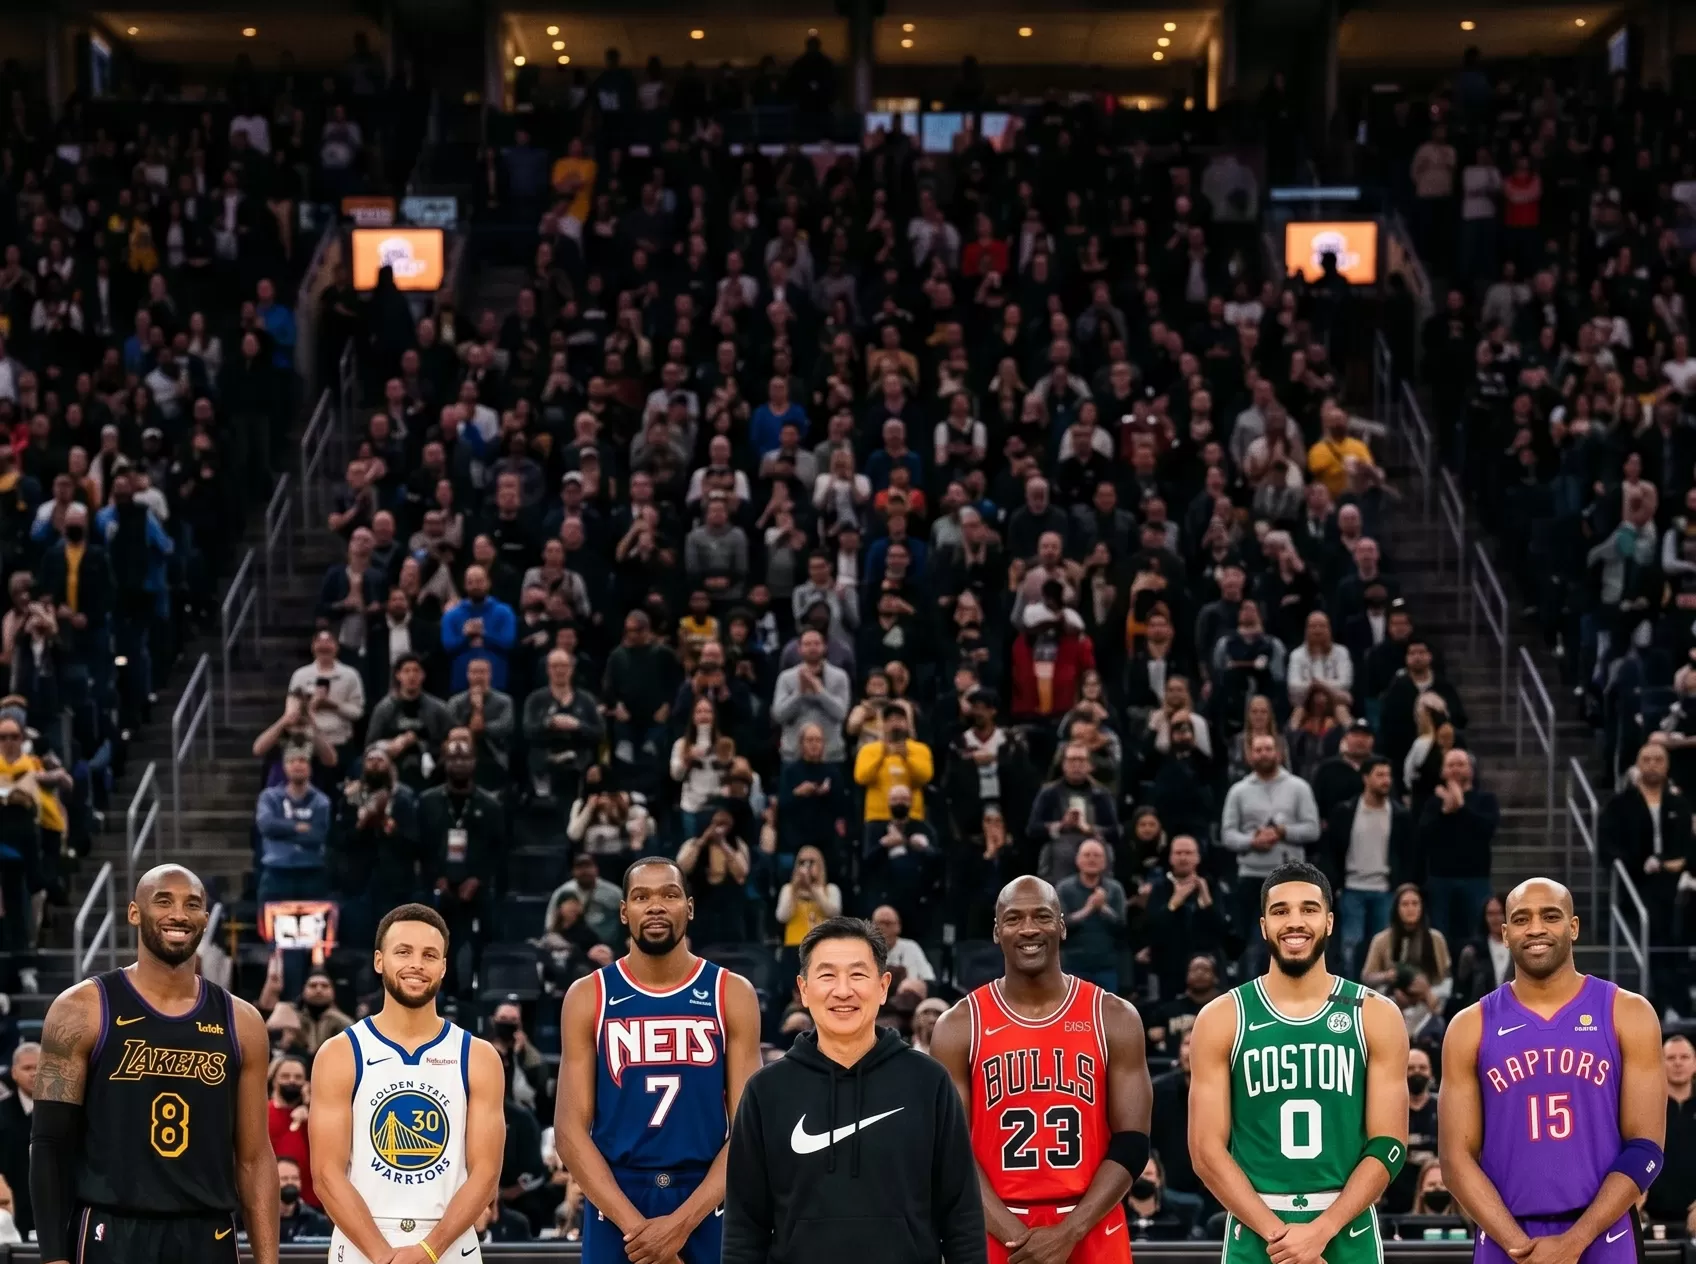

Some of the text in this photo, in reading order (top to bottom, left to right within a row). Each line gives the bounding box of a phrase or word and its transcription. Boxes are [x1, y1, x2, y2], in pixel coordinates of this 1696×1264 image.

[109, 1039, 227, 1086] LAKERS
[605, 1016, 719, 1088] NETS
[1243, 1043, 1355, 1097] COSTON
[1487, 1048, 1610, 1093] RAPTORS
[370, 1080, 451, 1107] GOLDEN STATE
[645, 1074, 681, 1127] 7
[982, 1048, 1095, 1111] BULLS
[151, 1092, 190, 1158] 8
[411, 1110, 439, 1132] 30
[1000, 1105, 1083, 1171] 23
[1280, 1099, 1323, 1160] 0
[1528, 1092, 1574, 1142] 15
[370, 1157, 451, 1185] WARRIORS
